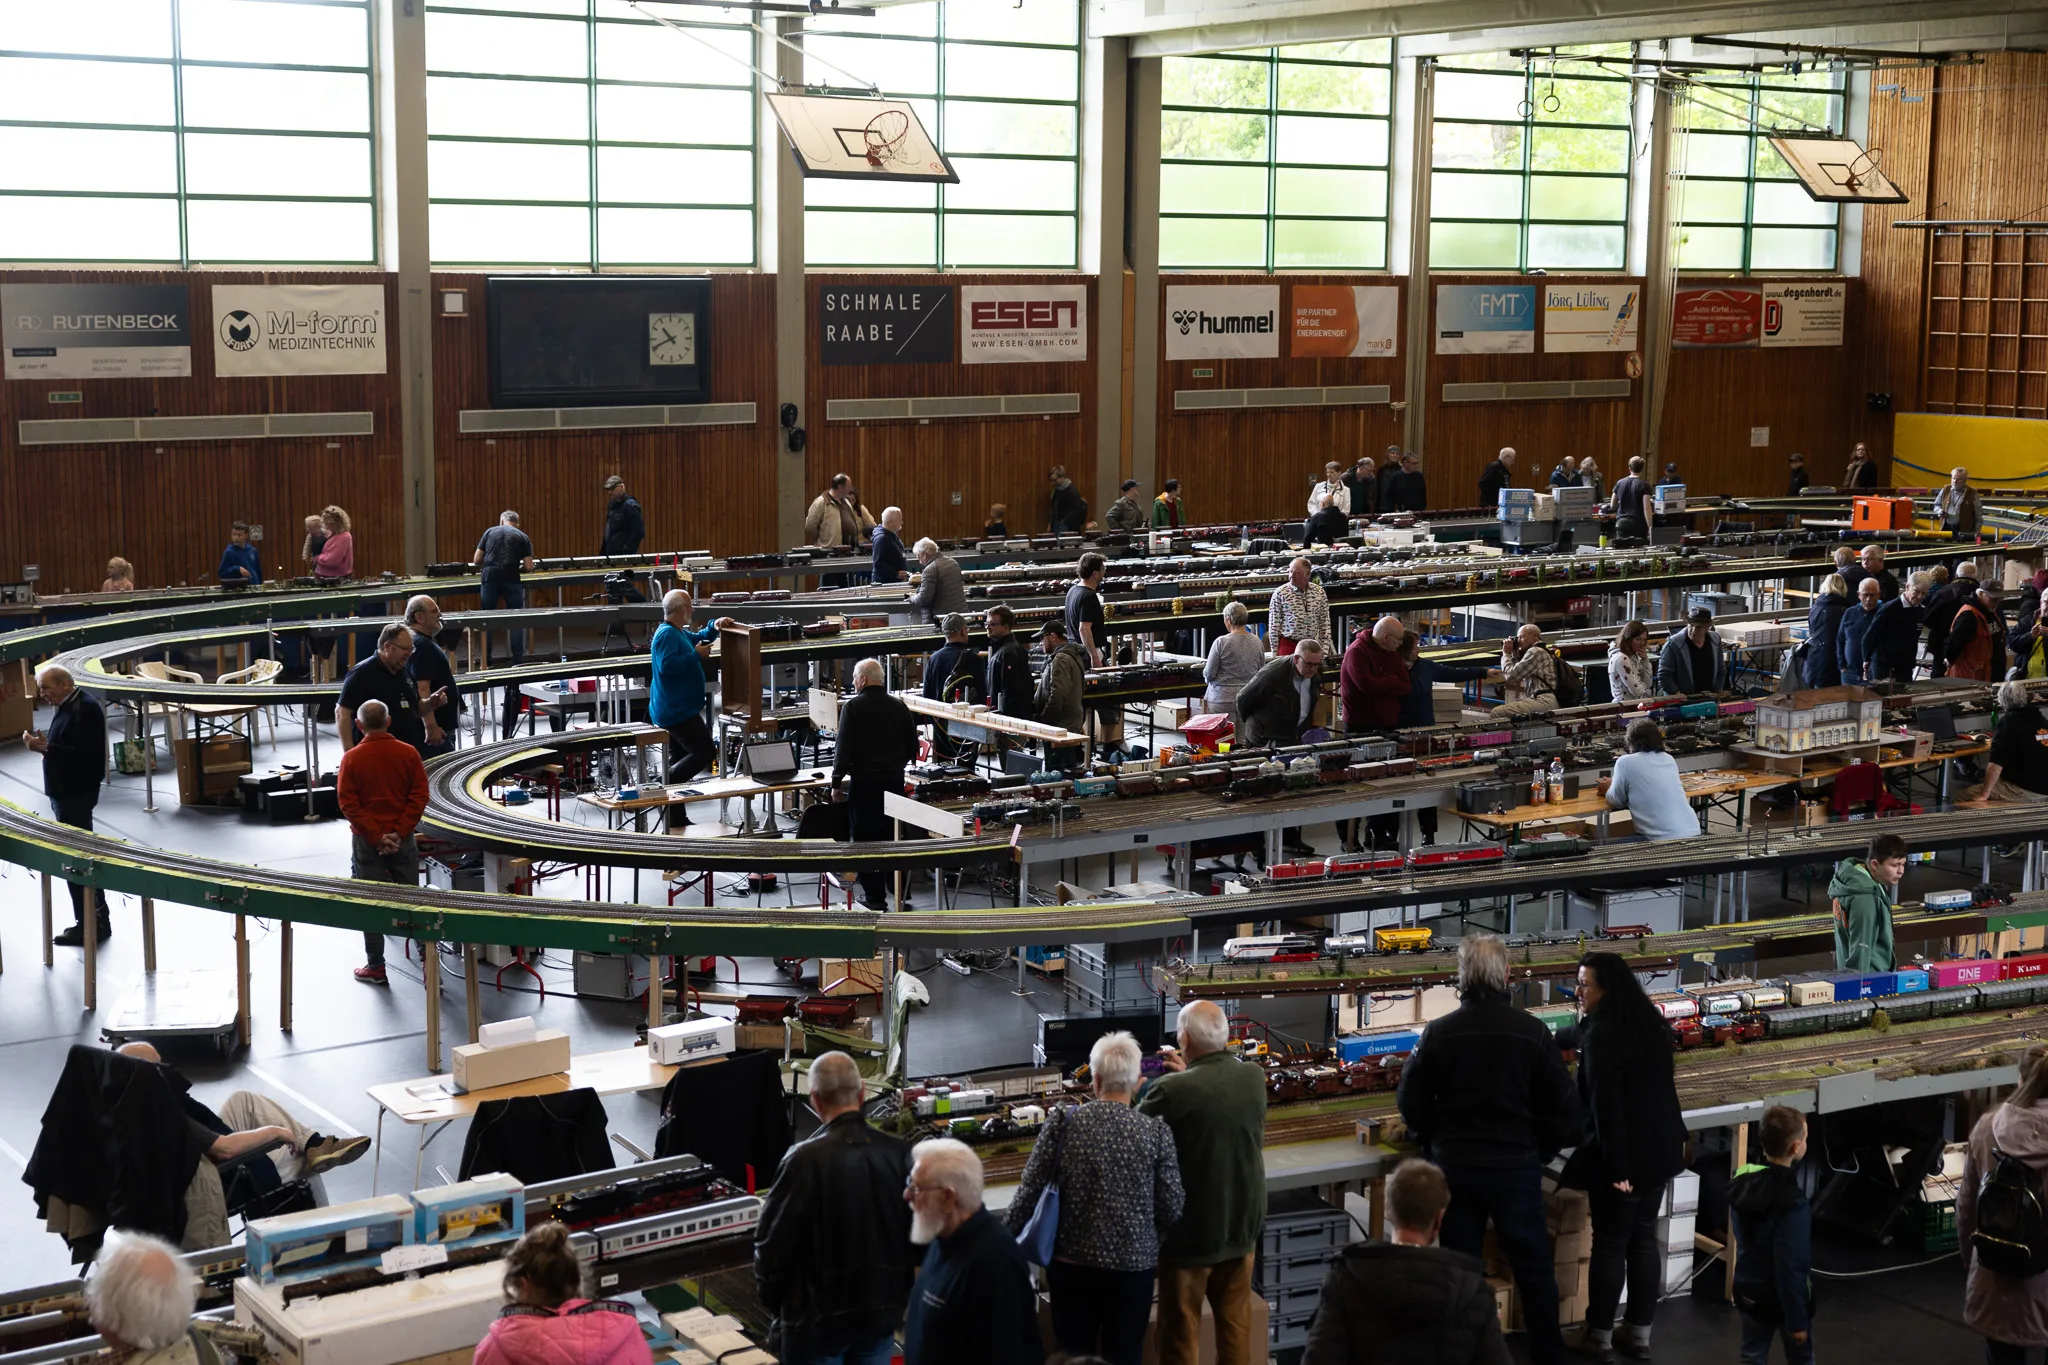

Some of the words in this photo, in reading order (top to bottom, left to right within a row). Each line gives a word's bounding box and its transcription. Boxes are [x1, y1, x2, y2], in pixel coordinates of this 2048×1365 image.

[1765, 286, 1842, 300] www.degenhardt.de
[826, 293, 921, 310] SCHMALE
[1480, 294, 1520, 316] FMT
[1296, 308, 1308, 316] IHR
[1308, 308, 1337, 316] PARTNER
[53, 314, 178, 330] RUTENBECK
[267, 311, 376, 335] M-form
[1199, 310, 1274, 334] hummel
[1296, 317, 1309, 326] FÜR
[1309, 318, 1321, 326] DIE
[826, 324, 894, 342] RAABE
[1296, 329, 1347, 337] ENERGIEWENDE!
[268, 337, 376, 350] MEDIZINTECHNIK
[971, 339, 1078, 348] WWW.ESEN-GMBH.COM
[1958, 967, 1981, 979] ONE
[1808, 990, 1828, 1000] IRISL
[1374, 1044, 1397, 1053] HANJIN
